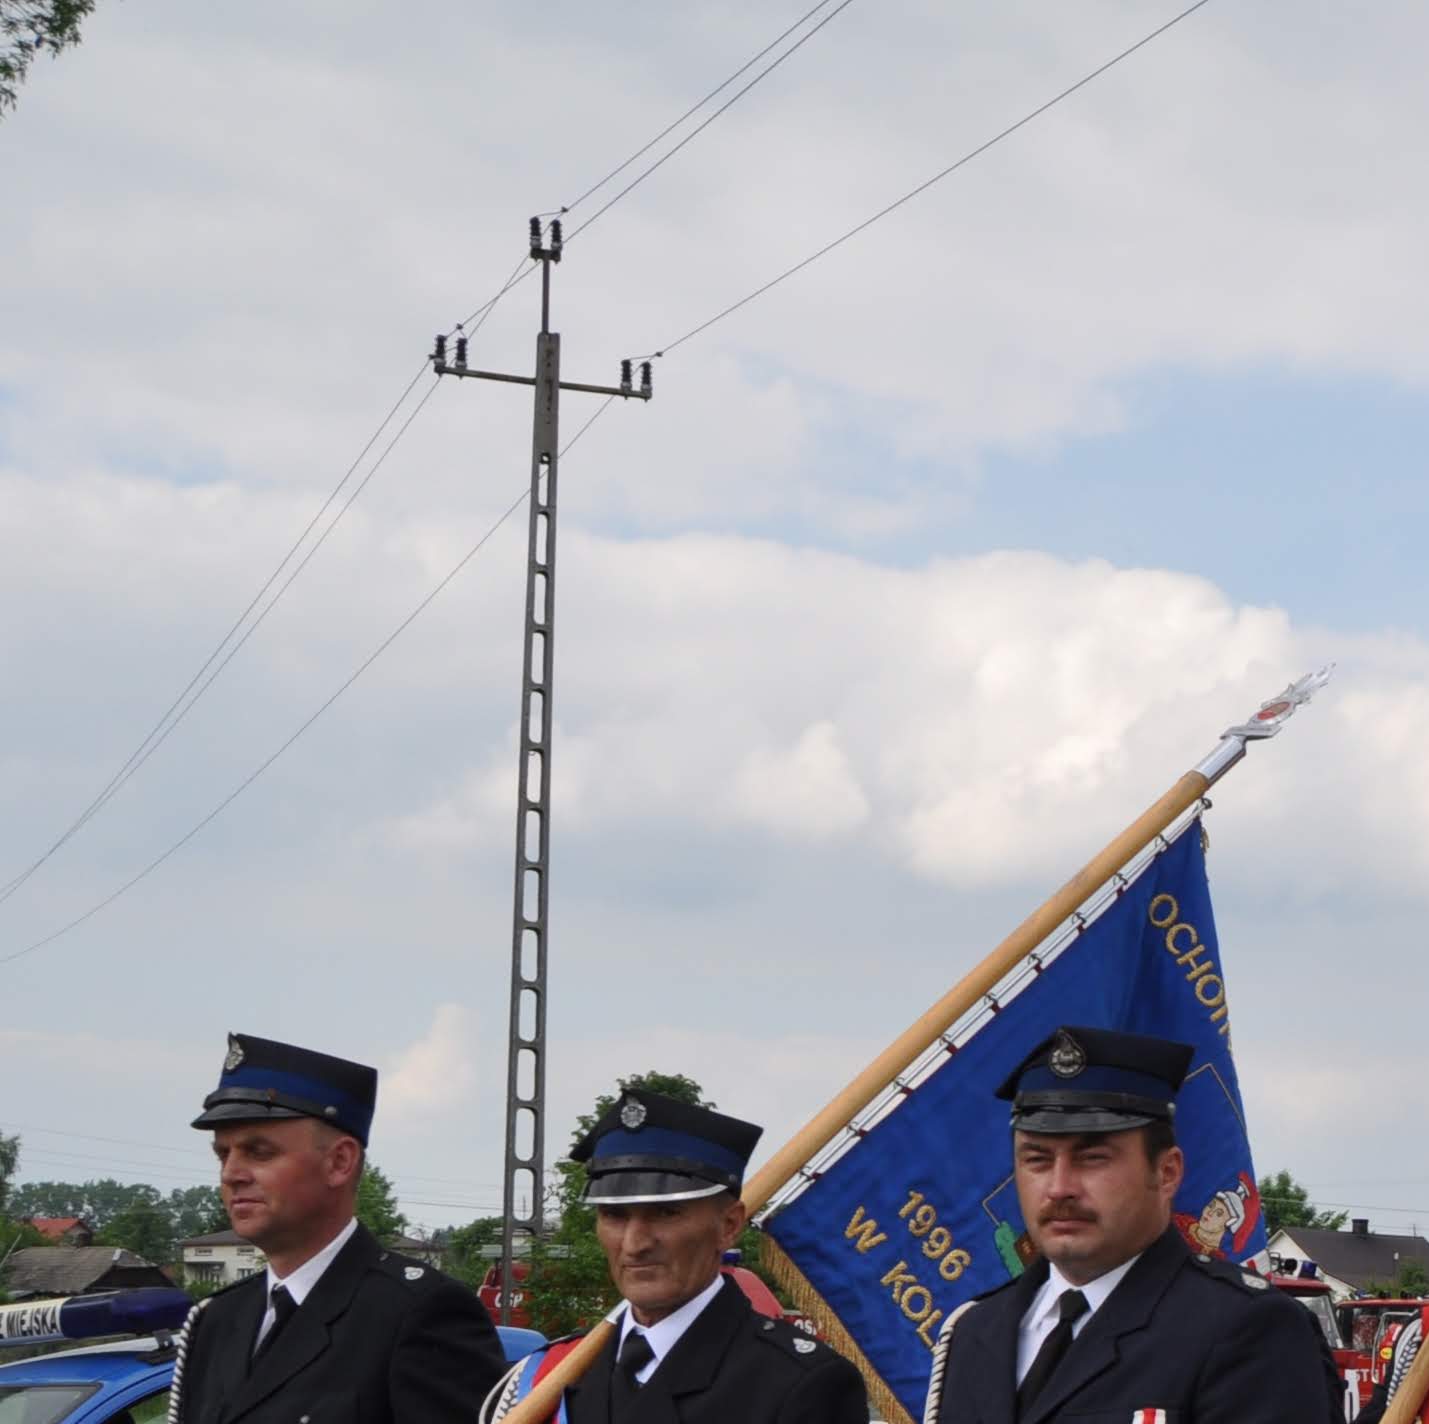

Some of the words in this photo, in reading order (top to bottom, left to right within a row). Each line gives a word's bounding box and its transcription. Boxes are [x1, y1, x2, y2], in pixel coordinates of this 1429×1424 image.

[844, 1205, 888, 1255] W
[897, 1190, 972, 1282] 1996
[7, 1306, 60, 1337] MIEJSKA
